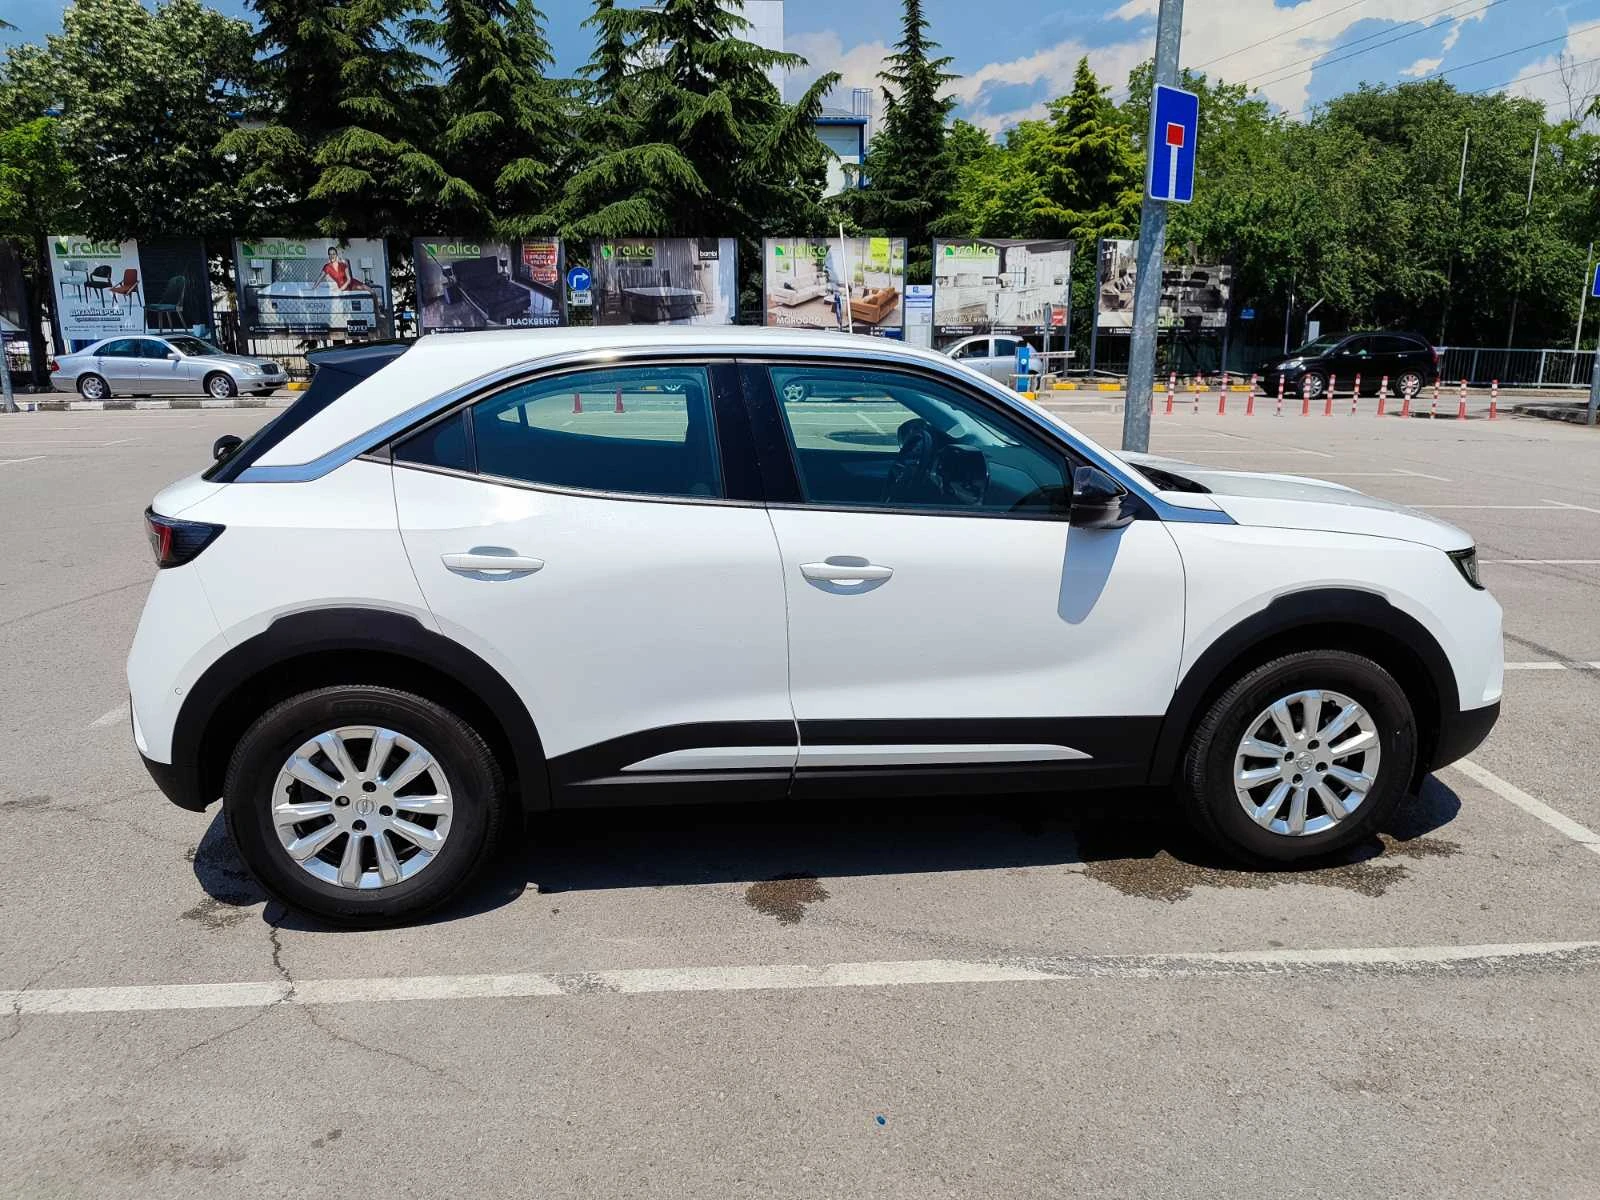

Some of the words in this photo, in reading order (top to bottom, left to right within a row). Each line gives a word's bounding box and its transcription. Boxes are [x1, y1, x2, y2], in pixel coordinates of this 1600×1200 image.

[440, 241, 481, 255] ralica
[959, 242, 996, 256] ralica
[506, 317, 560, 327] BLACKBERRY
[1157, 315, 1185, 328] alica
